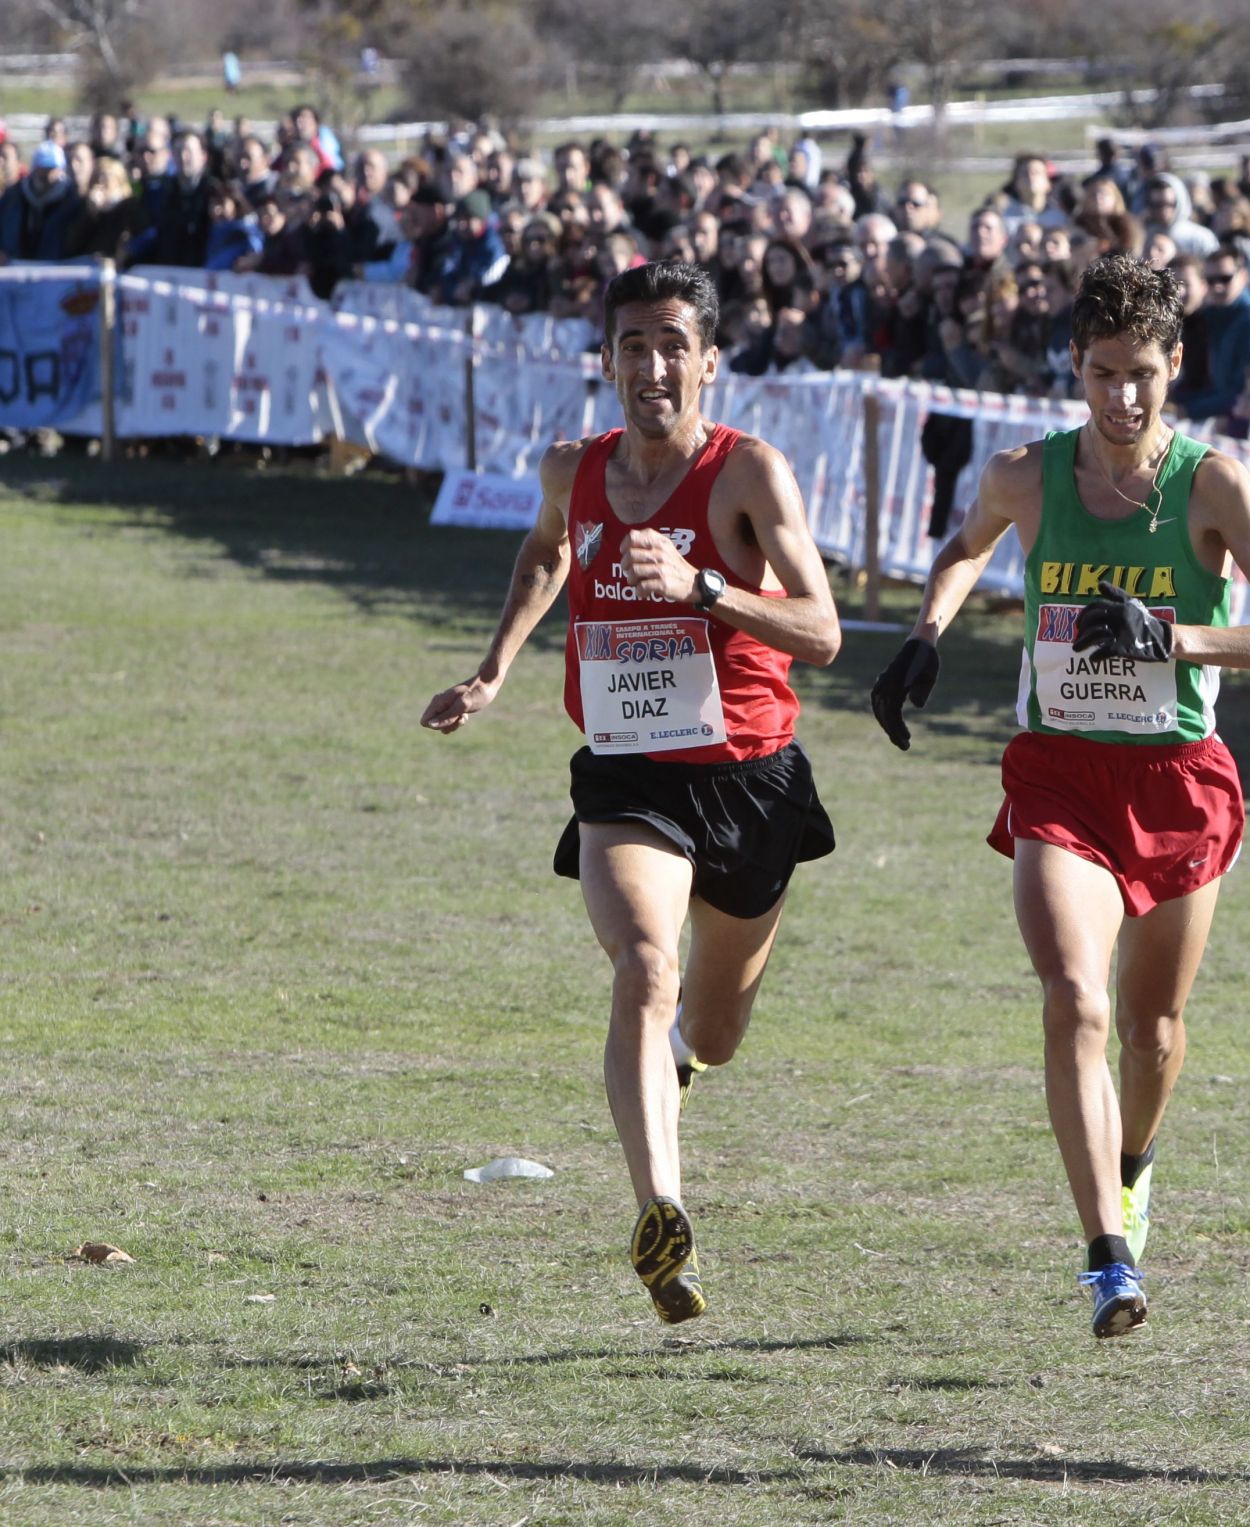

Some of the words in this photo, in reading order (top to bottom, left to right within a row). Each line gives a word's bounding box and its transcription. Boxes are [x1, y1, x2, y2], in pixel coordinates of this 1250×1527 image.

[1040, 561, 1177, 598] BIKILA
[615, 625, 641, 633] CAMPO
[1043, 606, 1079, 640] XIX
[585, 624, 612, 660] XIX
[616, 630, 674, 639] INTERNACIONAL
[616, 636, 696, 664] SORIA
[1066, 657, 1137, 677] JAVIER
[607, 670, 677, 693] JAVIER
[1060, 682, 1147, 702] GUERRA
[622, 698, 668, 720] DIAZ
[650, 727, 699, 739] E.LECLERC
